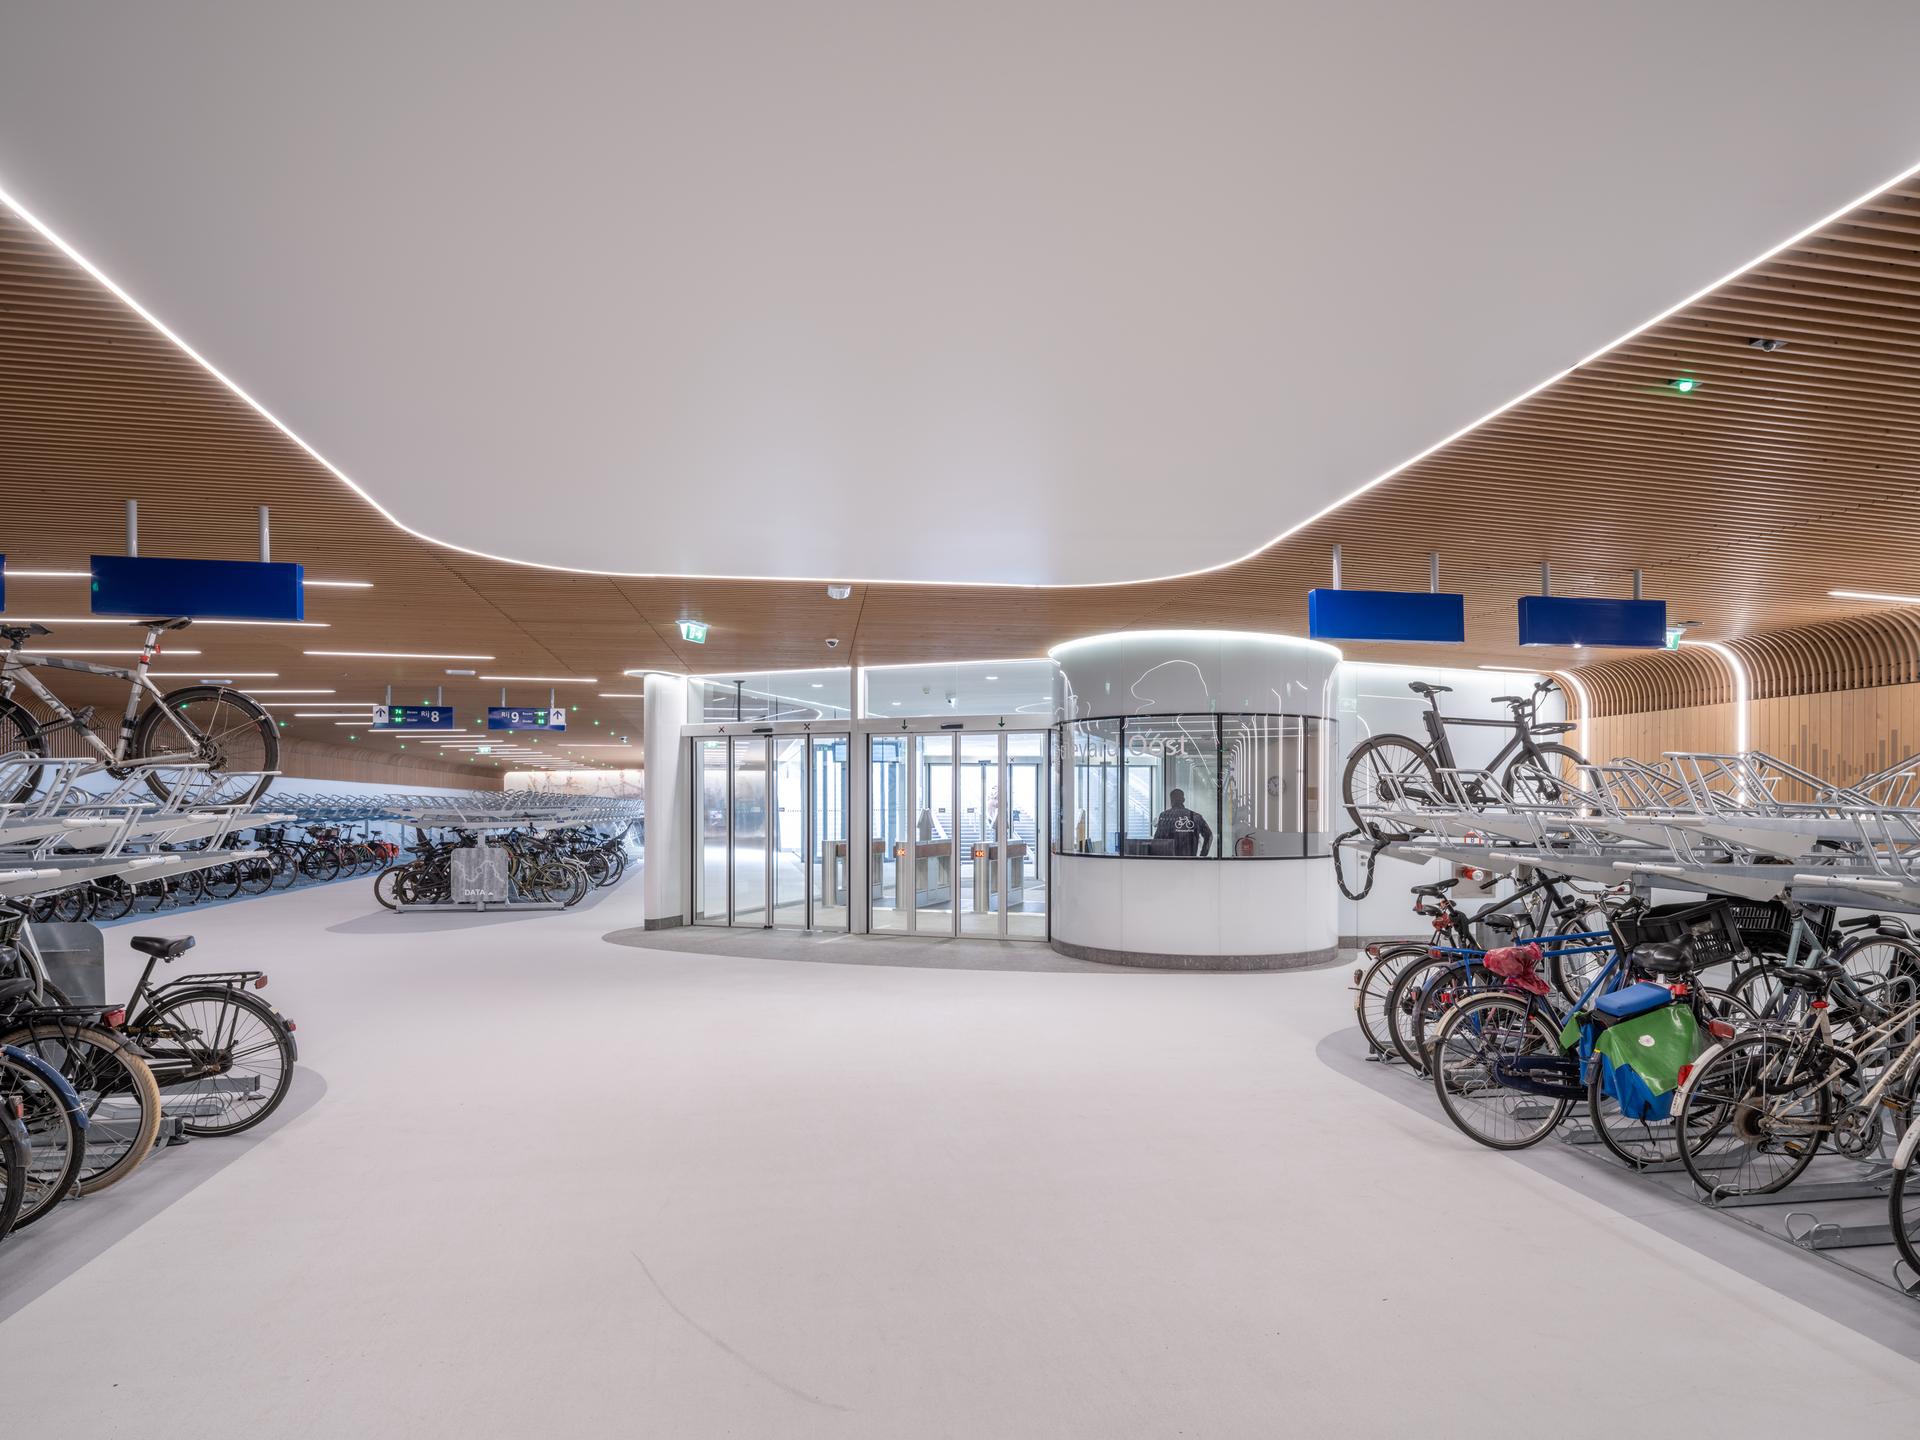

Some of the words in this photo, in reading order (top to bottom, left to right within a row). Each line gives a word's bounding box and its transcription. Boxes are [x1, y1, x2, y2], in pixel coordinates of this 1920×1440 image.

[421, 710, 430, 718] Rij
[430, 710, 440, 723] 8
[501, 711, 510, 719] Rij
[511, 711, 520, 723] 9
[1128, 734, 1189, 756] Oost
